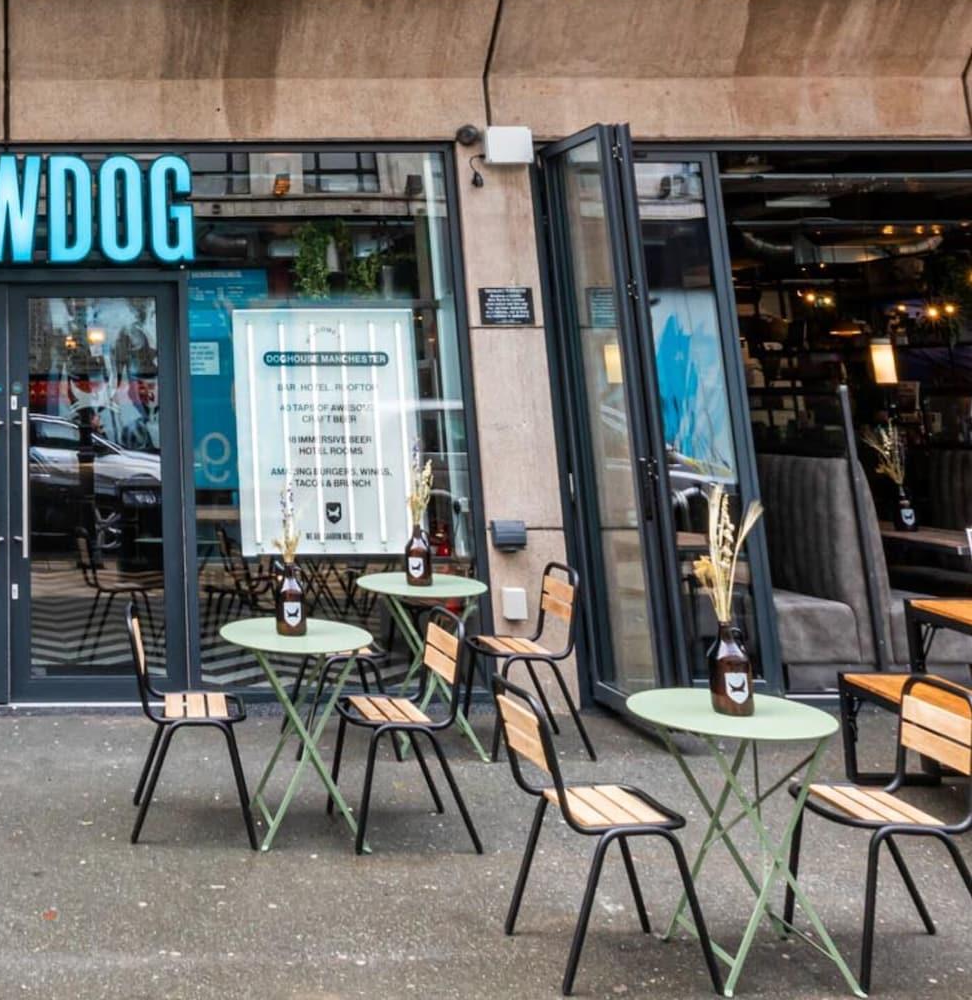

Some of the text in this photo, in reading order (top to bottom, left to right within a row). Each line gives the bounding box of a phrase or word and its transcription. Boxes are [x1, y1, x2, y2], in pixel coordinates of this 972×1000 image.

[266, 354, 386, 363] DOGHOUSE MANCHESTER
[334, 383, 379, 392] ROFTO
[317, 404, 329, 412] OF
[330, 404, 376, 412] AWSO
[301, 415, 357, 423] CRFT BER
[298, 435, 346, 443] IMMRSIVE
[270, 468, 312, 476] AMING
[359, 468, 393, 477] WINS,
[325, 479, 332, 487] &
